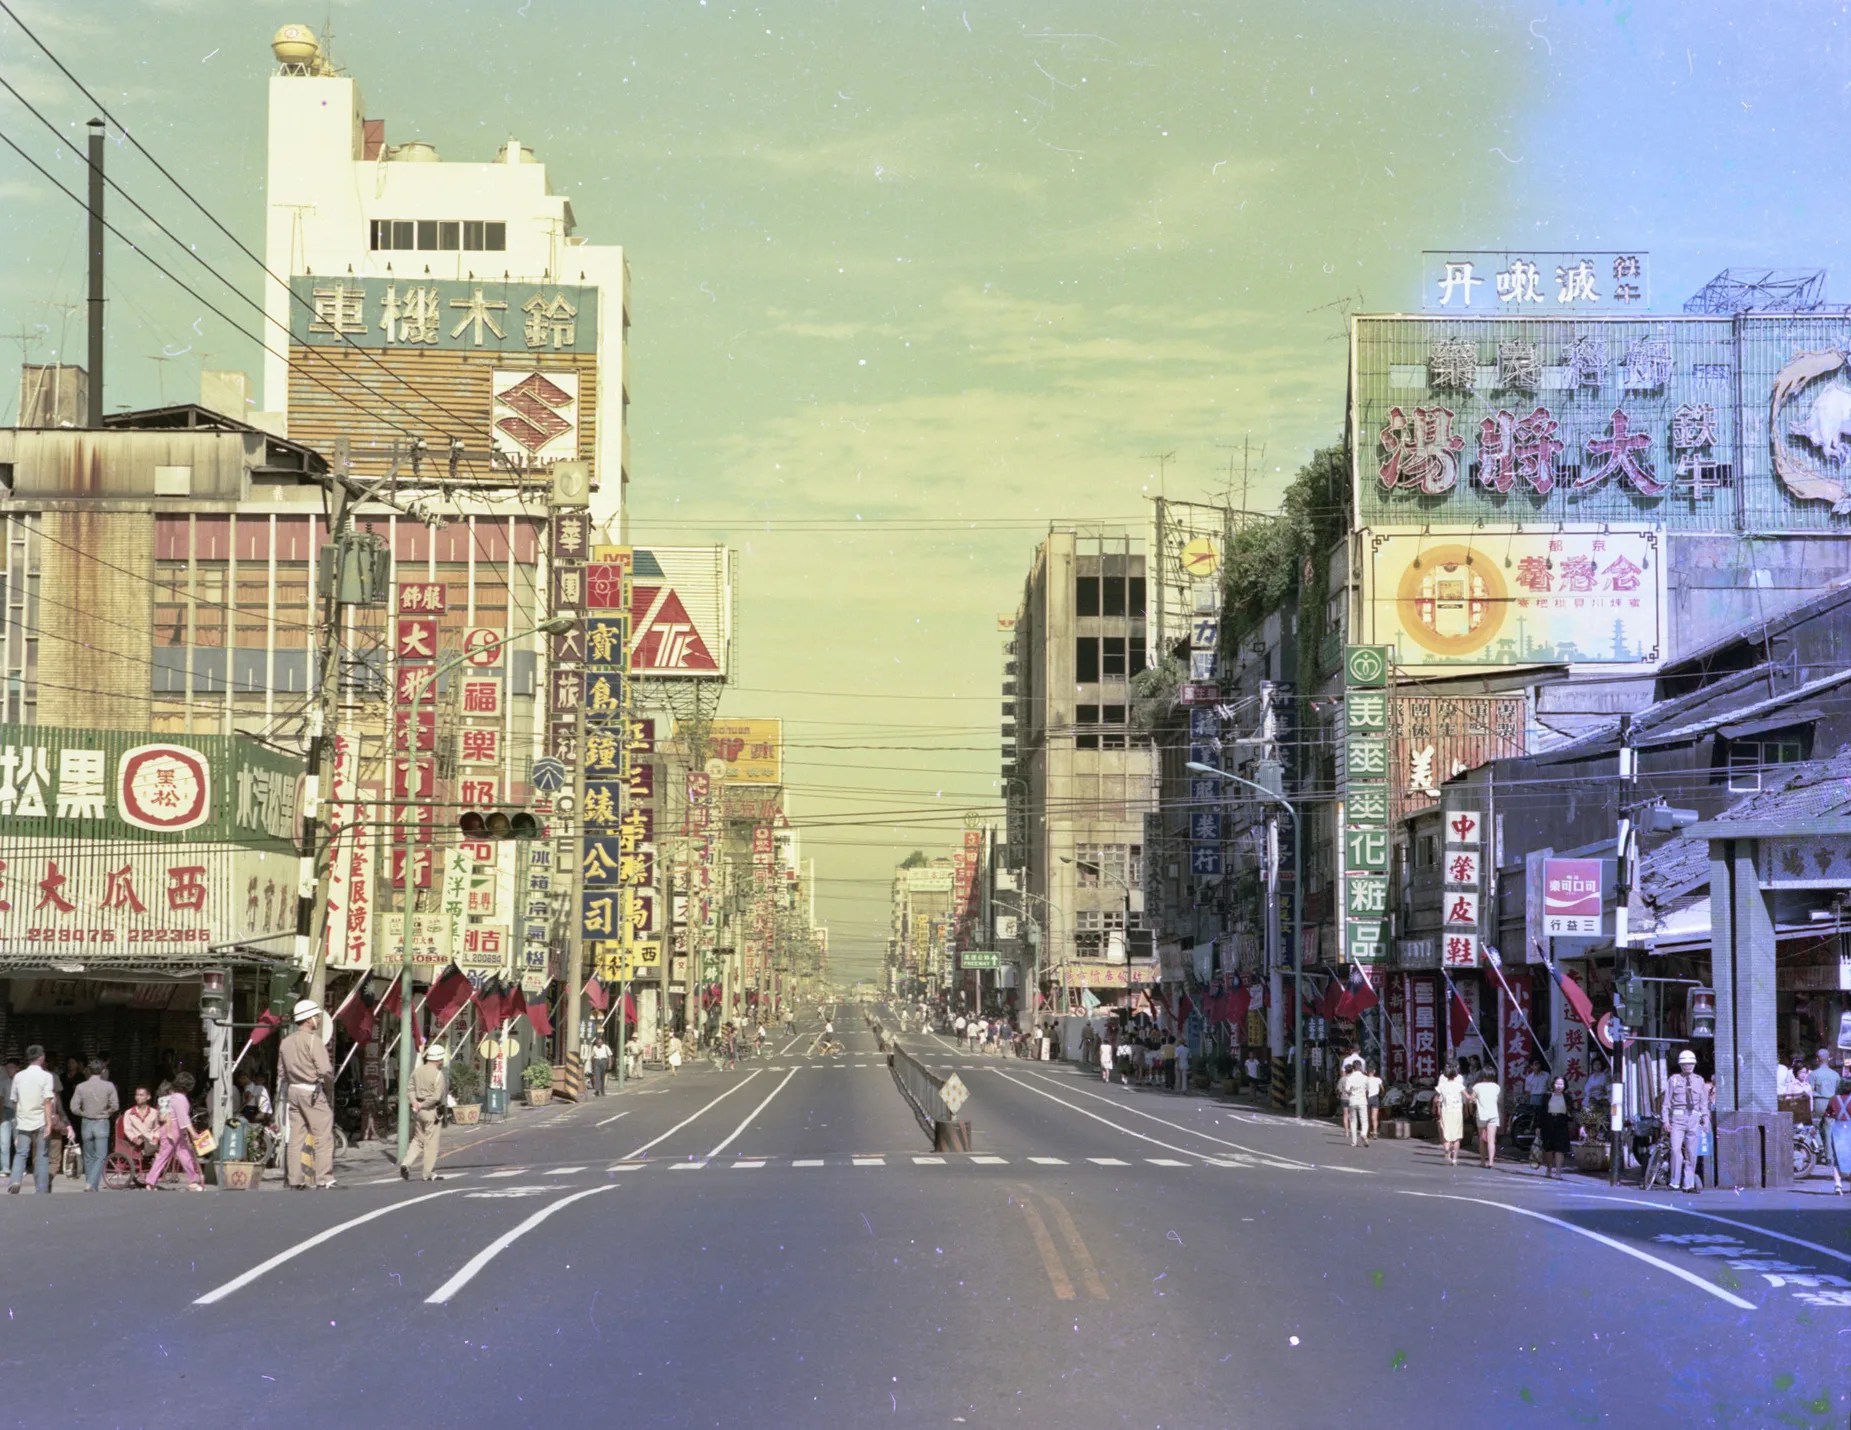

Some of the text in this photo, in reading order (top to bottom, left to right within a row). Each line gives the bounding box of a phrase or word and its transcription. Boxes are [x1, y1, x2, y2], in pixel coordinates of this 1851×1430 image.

[309, 282, 578, 350] 鈴木機車
[1378, 406, 1670, 498] 大將湯
[400, 585, 444, 610] 服飾
[151, 769, 180, 807] 黑松
[584, 622, 620, 935] 寶島鐘錶公司
[1348, 696, 1387, 958] 美爽爽化粧品
[1550, 880, 1596, 892] 可口可樂
[1781, 848, 1851, 877] 市場
[526, 850, 551, 966] 冰箱冷氣機
[1551, 920, 1594, 931] 三益行
